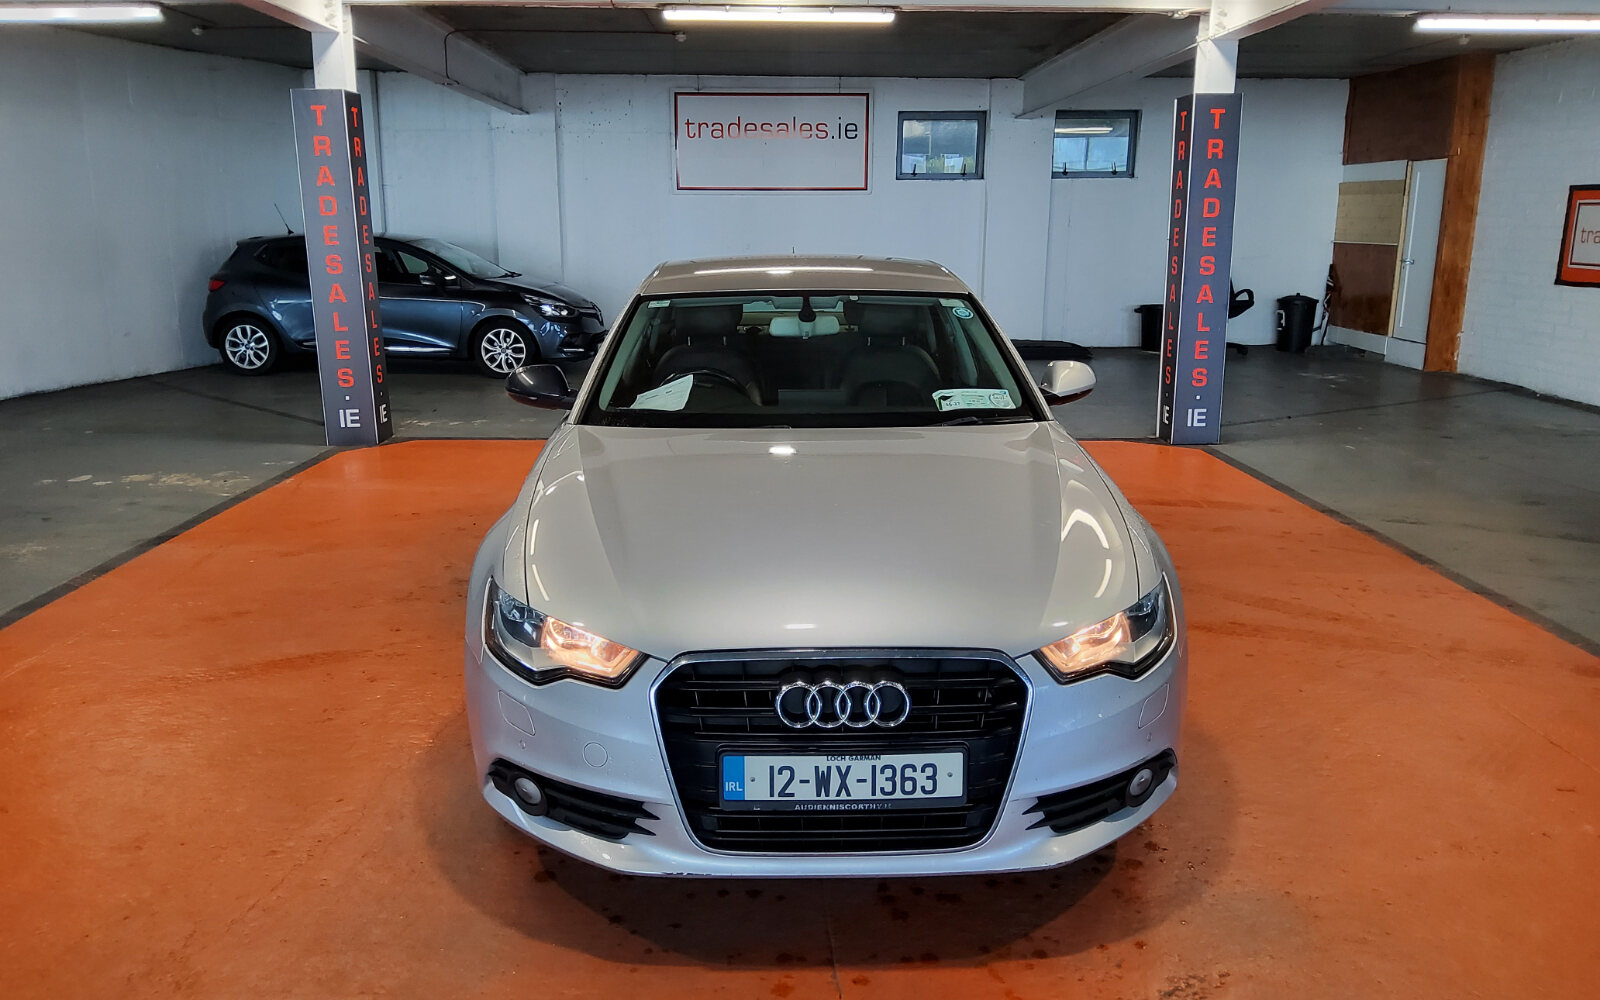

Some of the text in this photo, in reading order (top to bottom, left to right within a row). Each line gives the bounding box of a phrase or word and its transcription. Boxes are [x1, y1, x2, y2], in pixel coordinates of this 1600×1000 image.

[684, 116, 858, 139] tradesales.ie
[725, 781, 743, 791] IRL
[768, 763, 938, 797] 12-WX-1363
